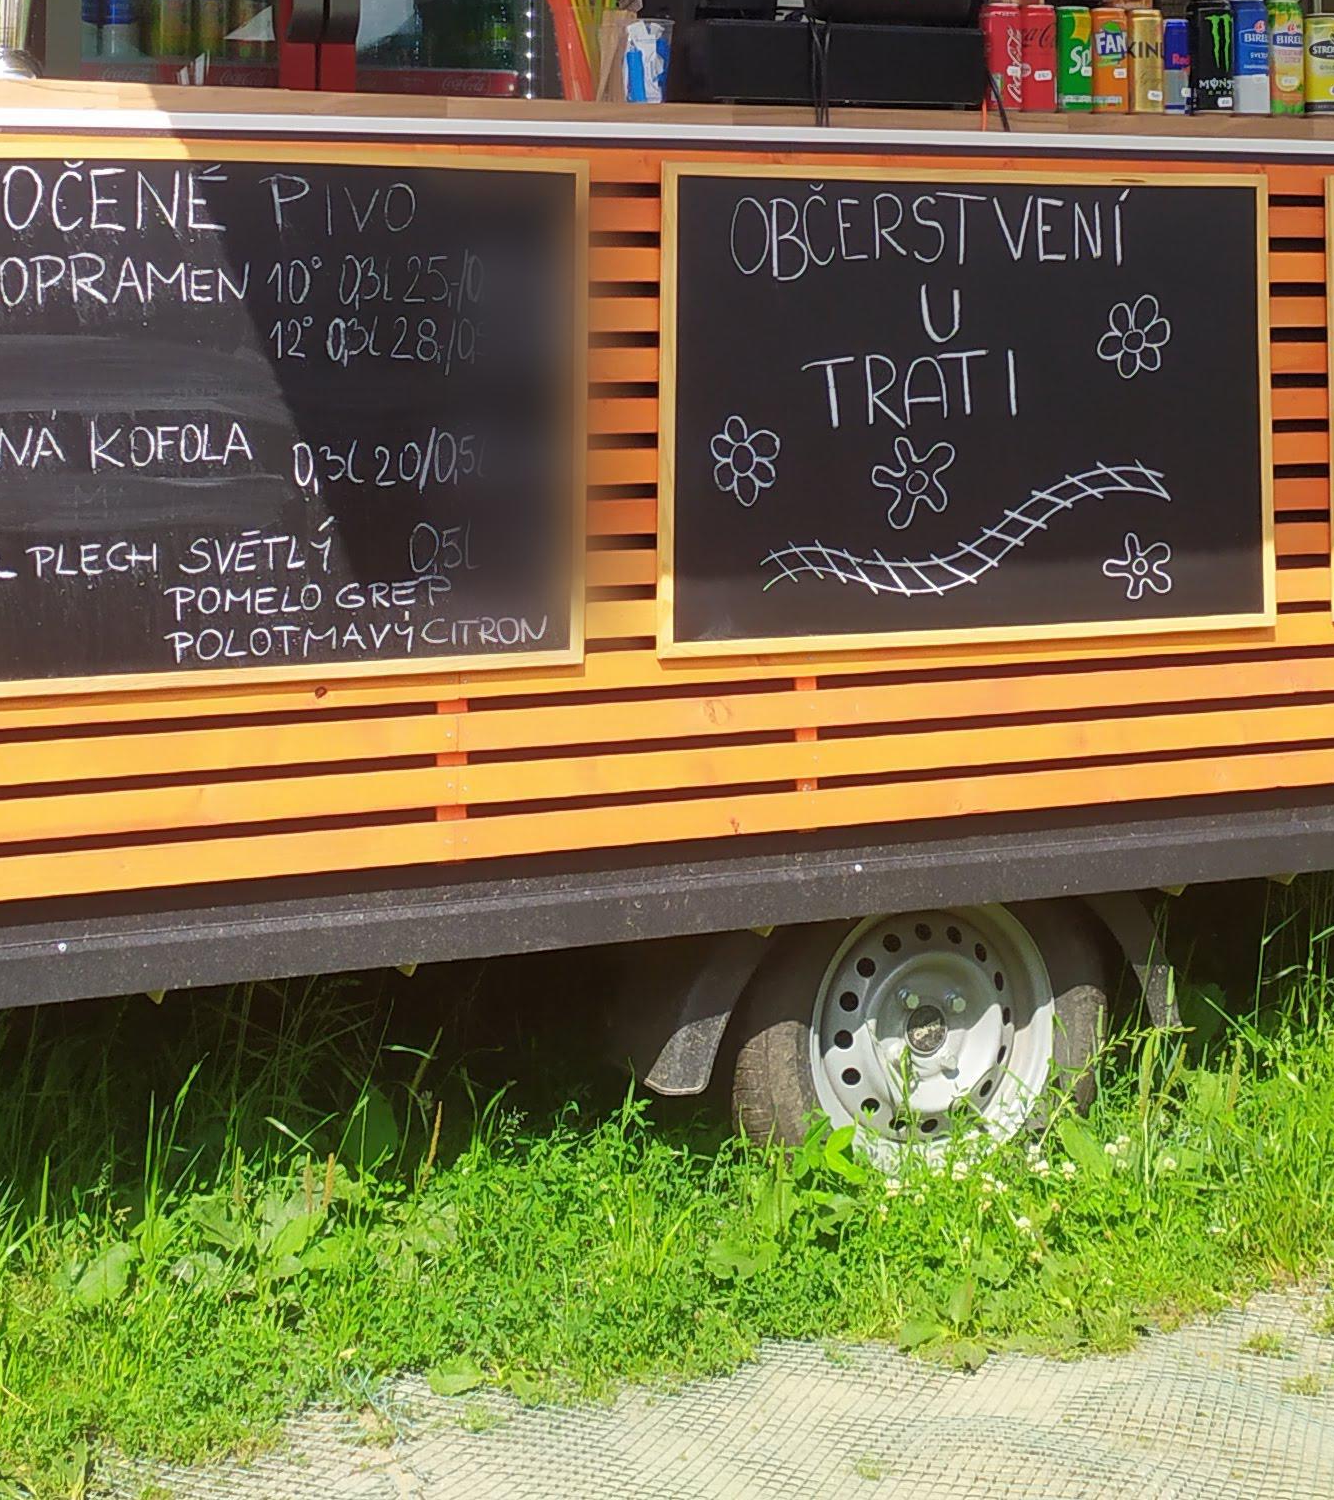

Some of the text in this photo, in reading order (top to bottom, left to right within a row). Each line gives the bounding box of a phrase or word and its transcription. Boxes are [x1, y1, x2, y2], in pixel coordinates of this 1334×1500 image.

[260, 173, 418, 235] PIVO
[730, 184, 1131, 280] OBČERSTVENÍ
[921, 284, 961, 343] U
[801, 349, 1018, 429] TRATI
[89, 420, 254, 474] KOFOLA
[26, 541, 158, 577] PLECH
[179, 516, 337, 575] SVĚTLÝ
[164, 574, 452, 622] POMELO GREP
[164, 611, 548, 664] POLOTMAVÝ CITRON
